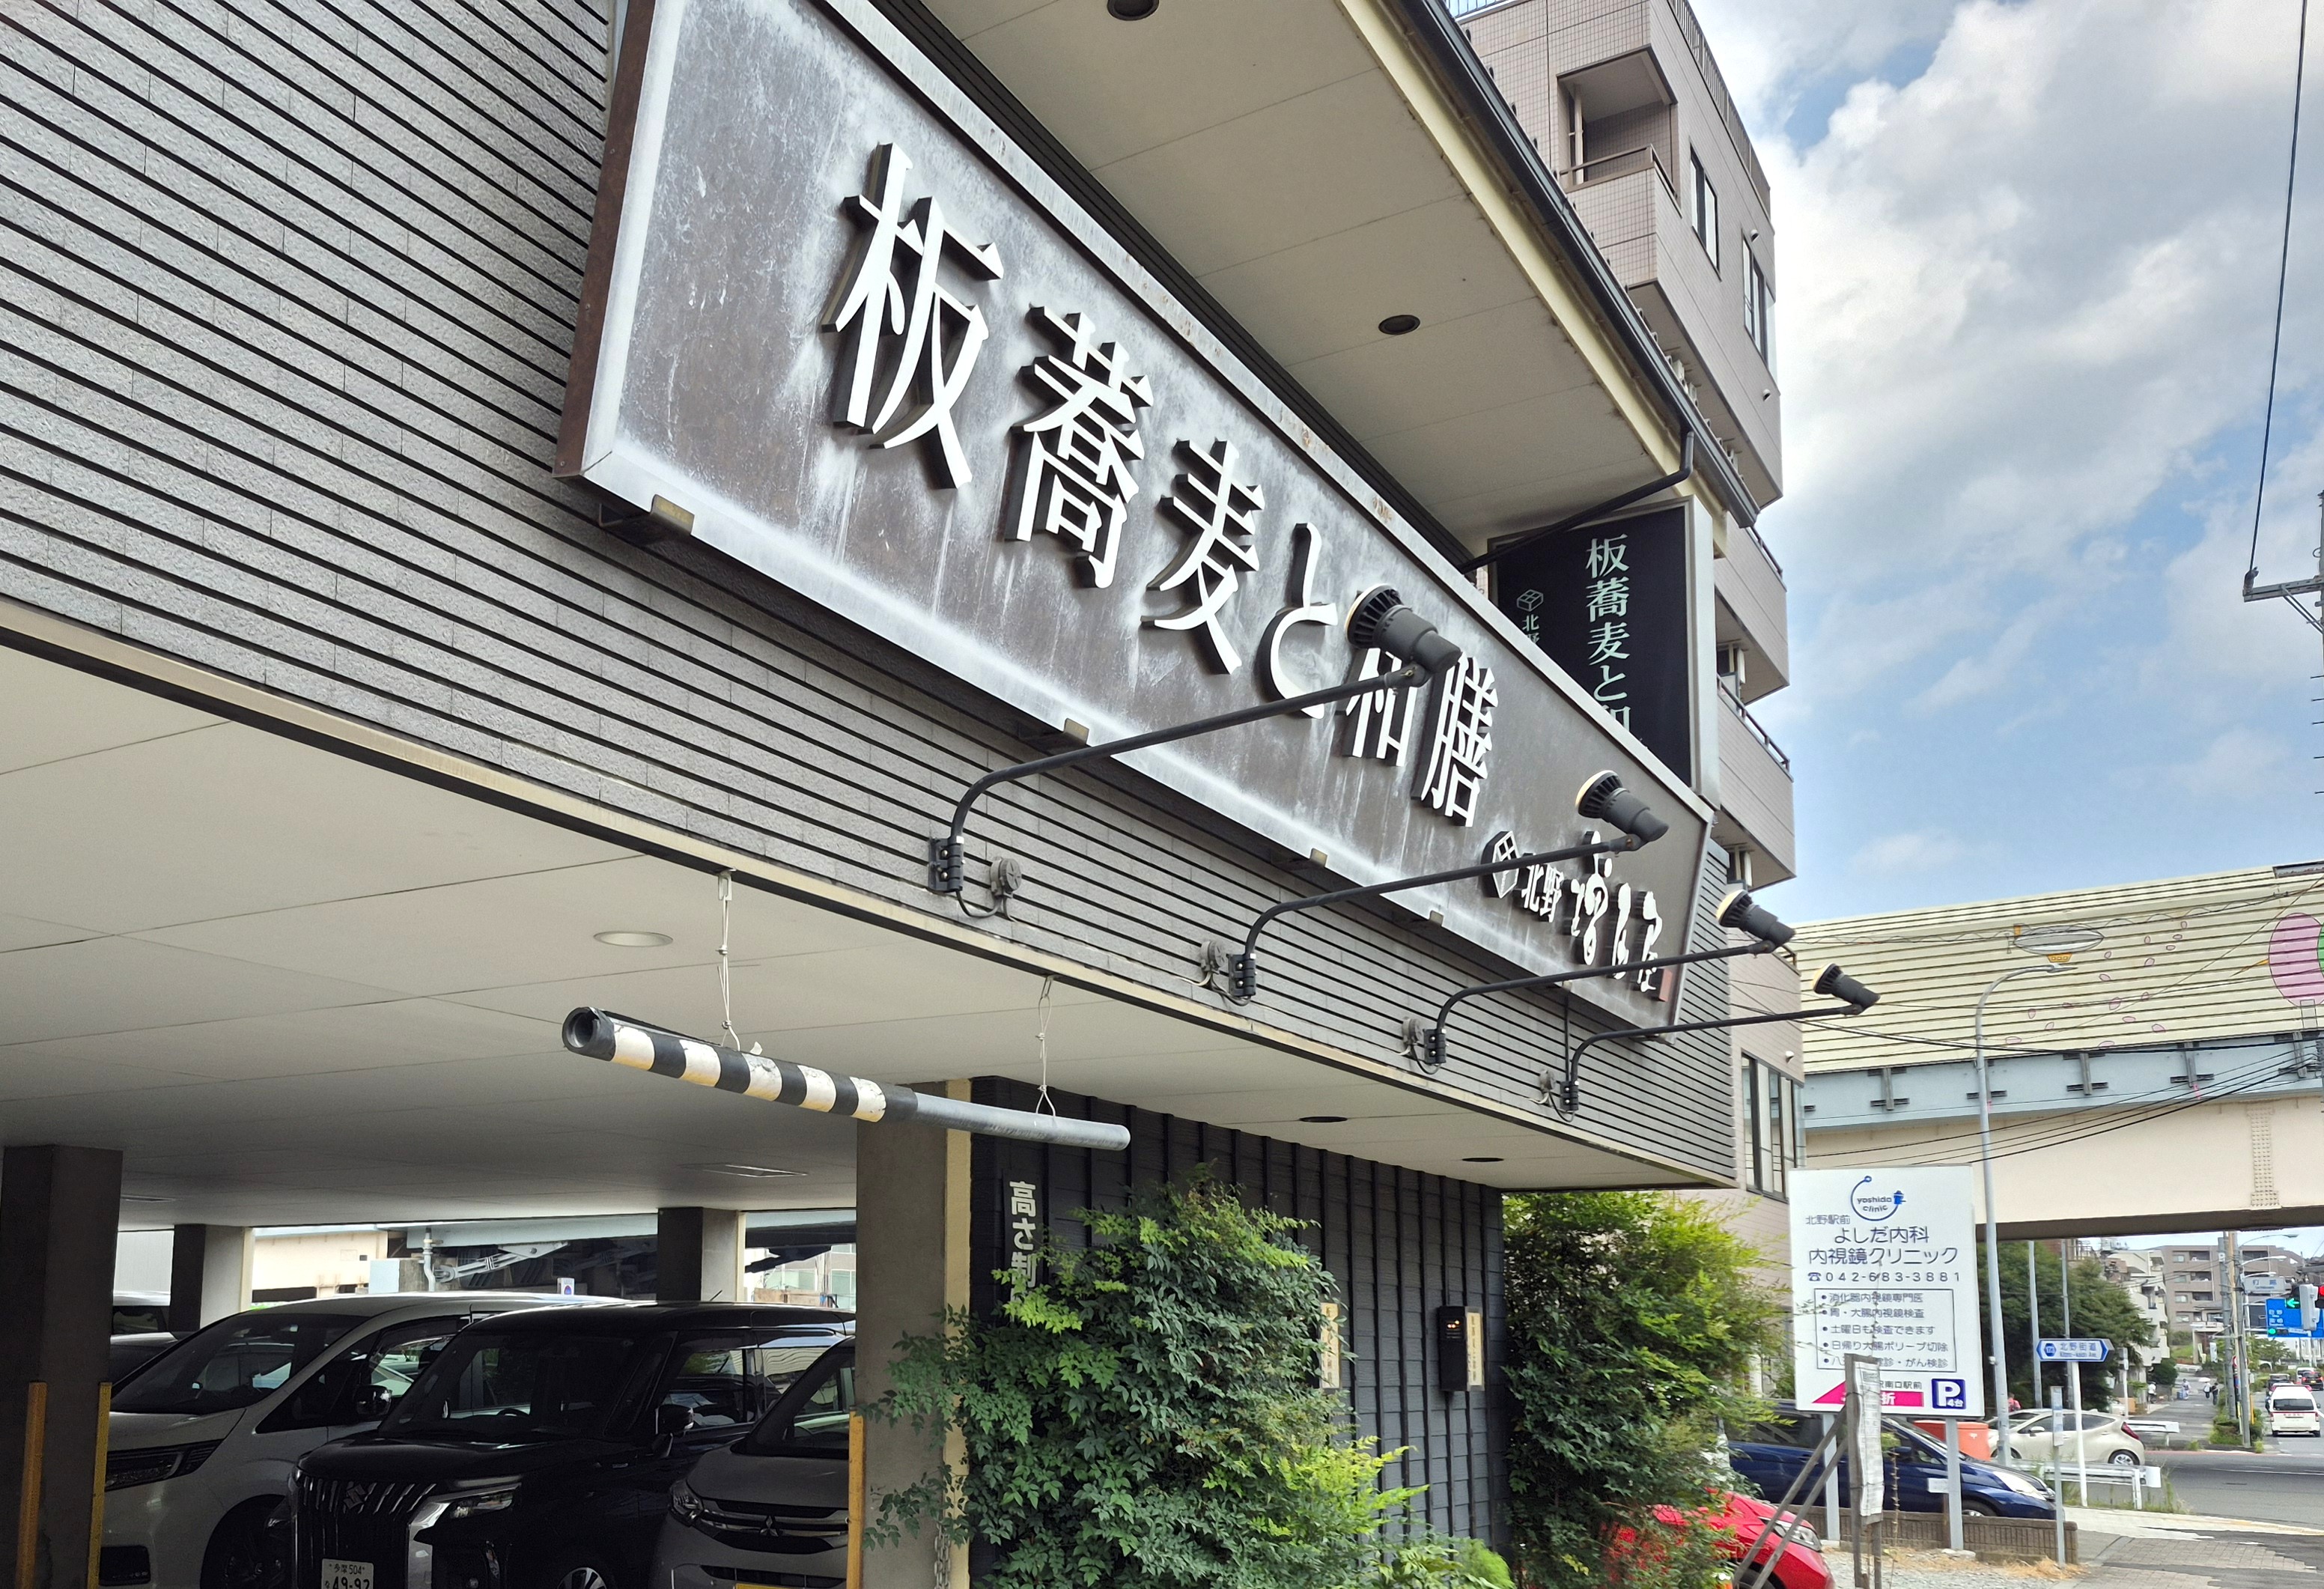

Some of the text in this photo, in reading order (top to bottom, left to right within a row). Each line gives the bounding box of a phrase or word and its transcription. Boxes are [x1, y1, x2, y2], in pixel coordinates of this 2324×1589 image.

[1857, 1196, 1892, 1204] yoshida
[1805, 1214, 1851, 1225] 北野駅前
[1834, 1226, 1929, 1244] よしだ内科
[1010, 1181, 1036, 1322] 高さ制
[1809, 1247, 1958, 1265] 内視鏡クリニック
[1831, 1325, 1935, 1335] 土曜日も検査できます
[1937, 1381, 1961, 1407] P
